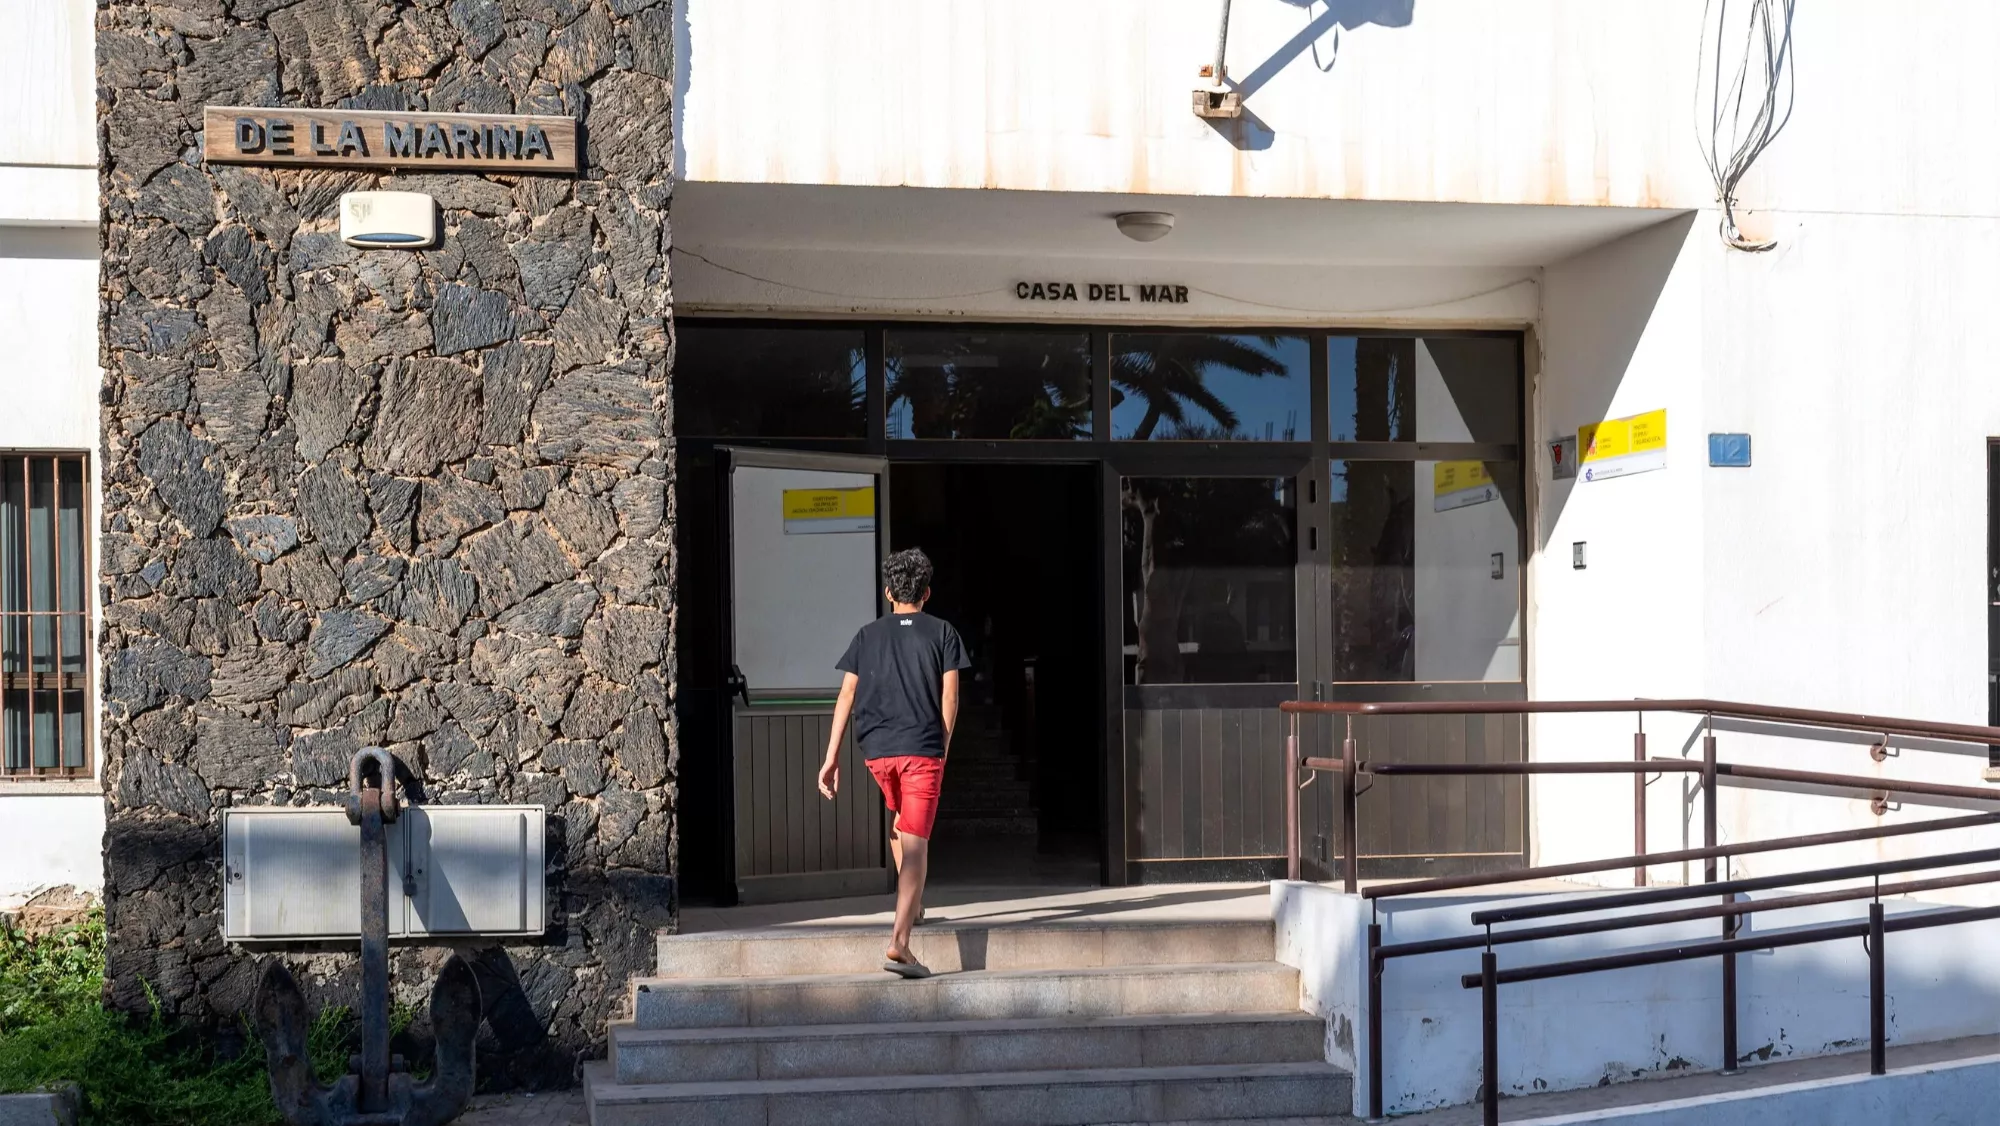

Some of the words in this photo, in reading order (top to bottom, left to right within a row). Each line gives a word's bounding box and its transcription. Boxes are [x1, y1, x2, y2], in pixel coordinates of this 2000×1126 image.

[234, 117, 291, 151] DE
[309, 119, 366, 154] LA
[383, 121, 551, 158] MARINA
[1016, 281, 1079, 301] CASA
[1088, 283, 1131, 302] DEL
[1139, 284, 1189, 303] MAR
[1717, 436, 1743, 461] 12
